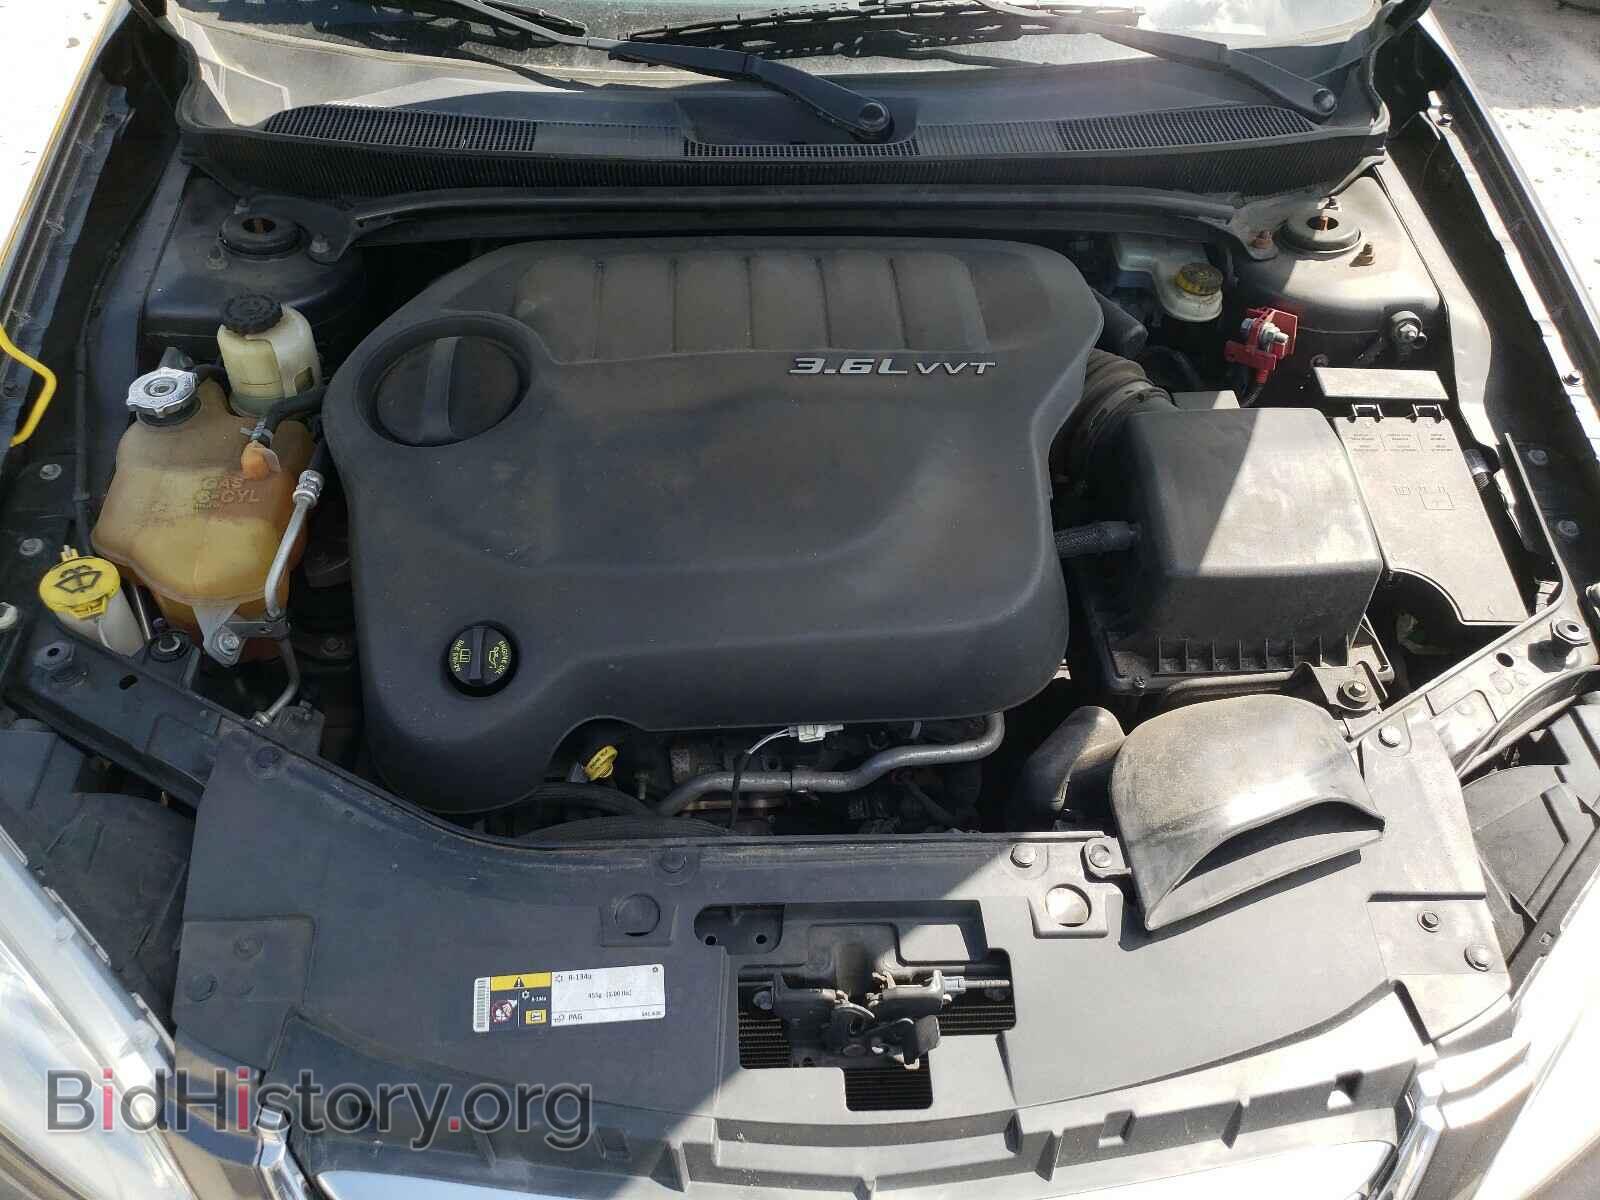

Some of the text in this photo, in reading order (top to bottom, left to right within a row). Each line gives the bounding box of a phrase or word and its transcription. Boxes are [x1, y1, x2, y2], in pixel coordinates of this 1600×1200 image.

[788, 357, 996, 375] 3.6L VVT
[498, 640, 509, 664] ENGINE
[568, 1013, 583, 1021] PAG
